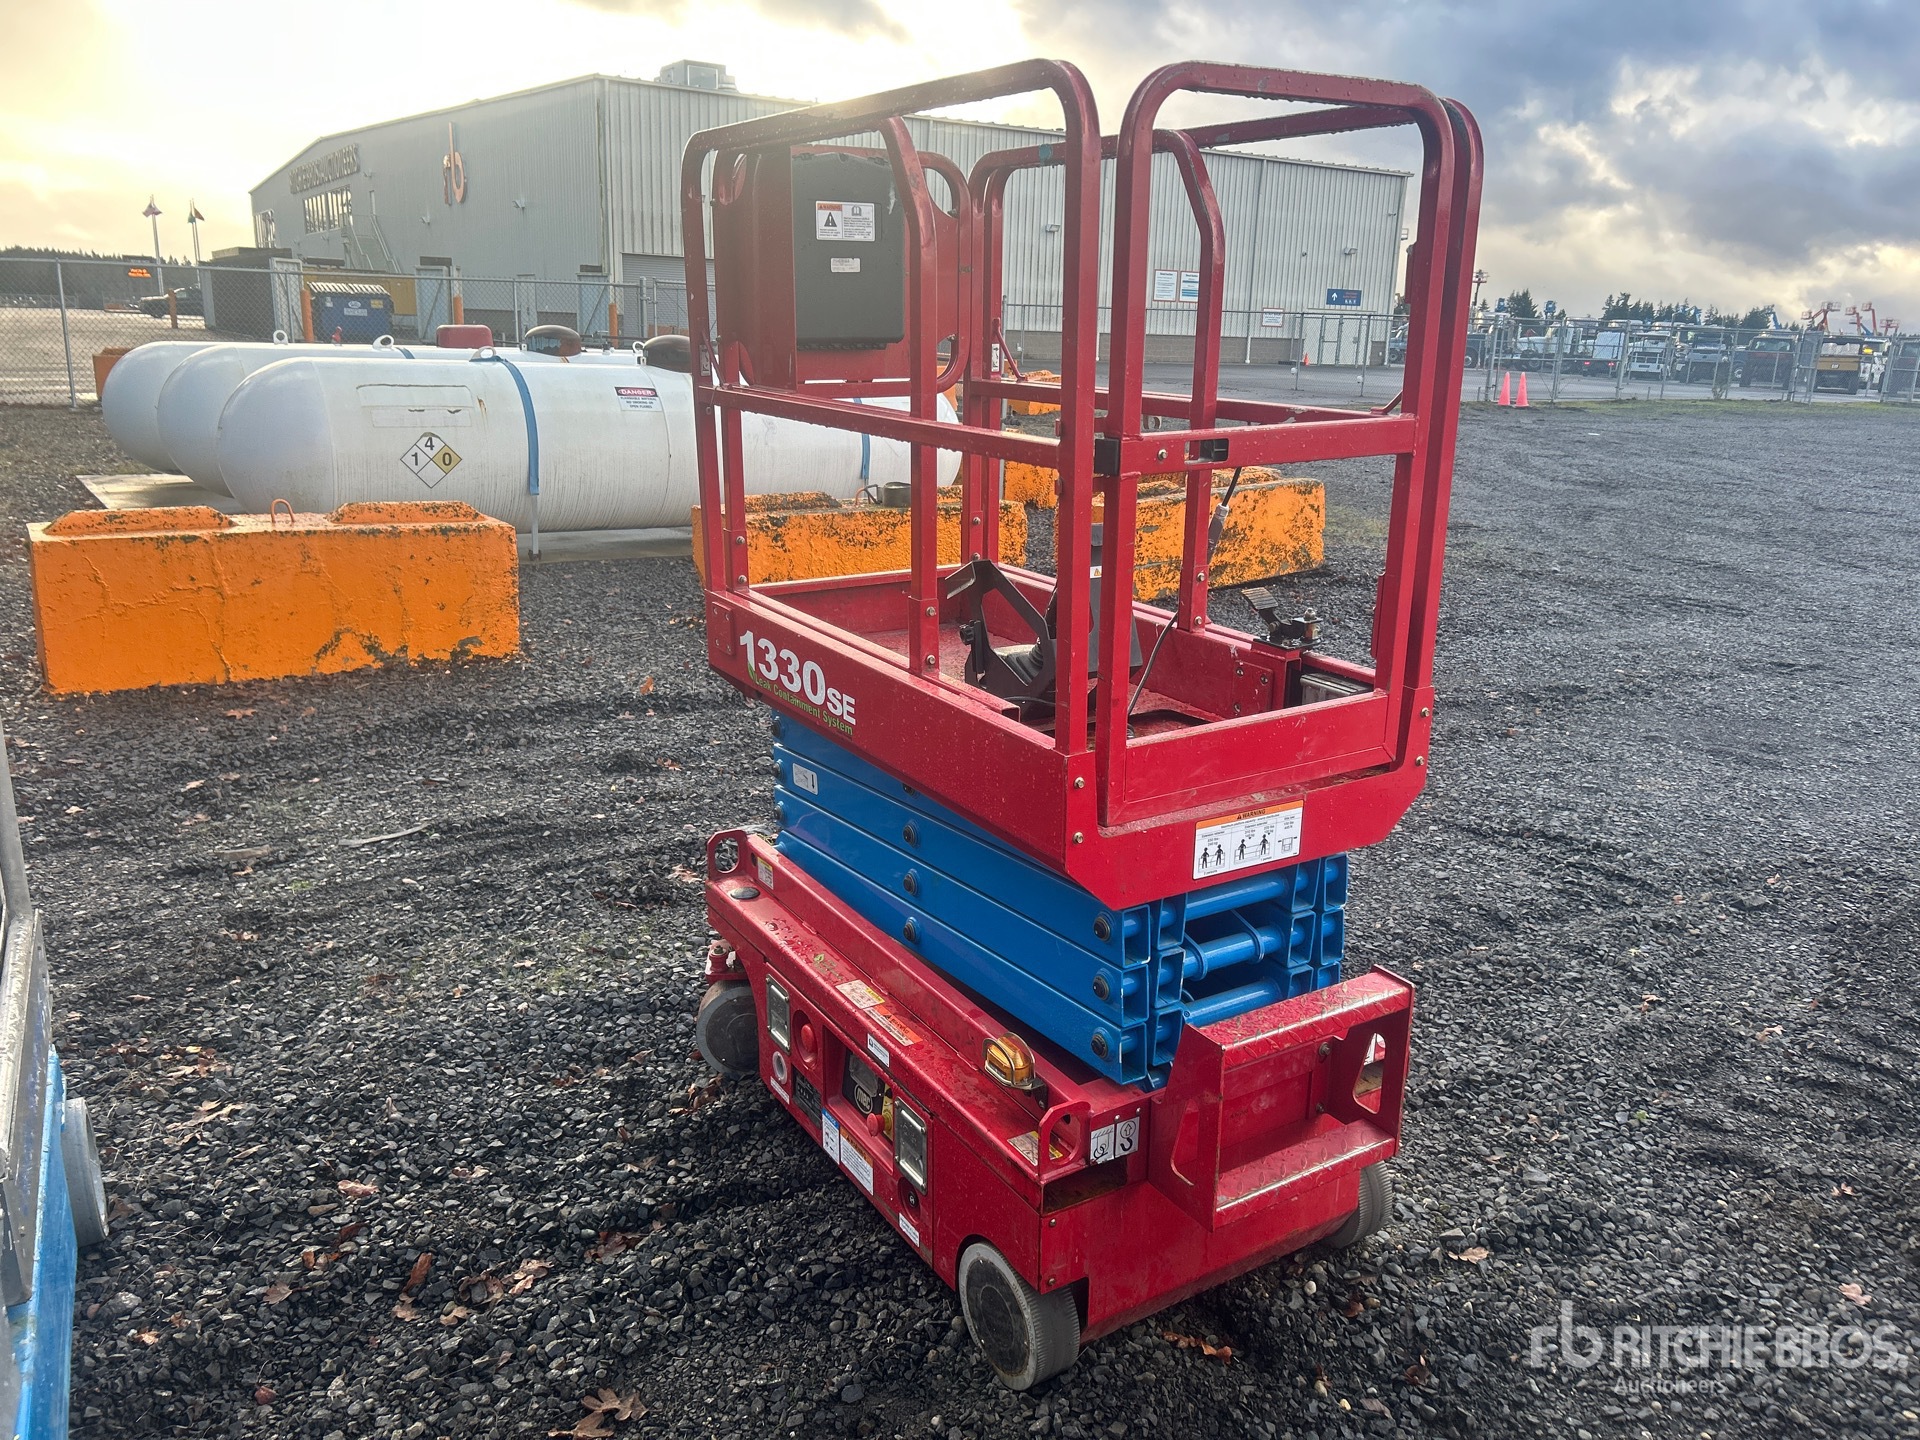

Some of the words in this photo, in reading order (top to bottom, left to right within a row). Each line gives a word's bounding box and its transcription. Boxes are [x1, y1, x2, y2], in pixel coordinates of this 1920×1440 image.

[621, 388, 652, 396] DANGER
[425, 437, 435, 451] 4
[411, 452, 419, 466] 1
[442, 452, 452, 467] 0
[822, 711, 853, 736] System
[1241, 808, 1266, 819] WARNING
